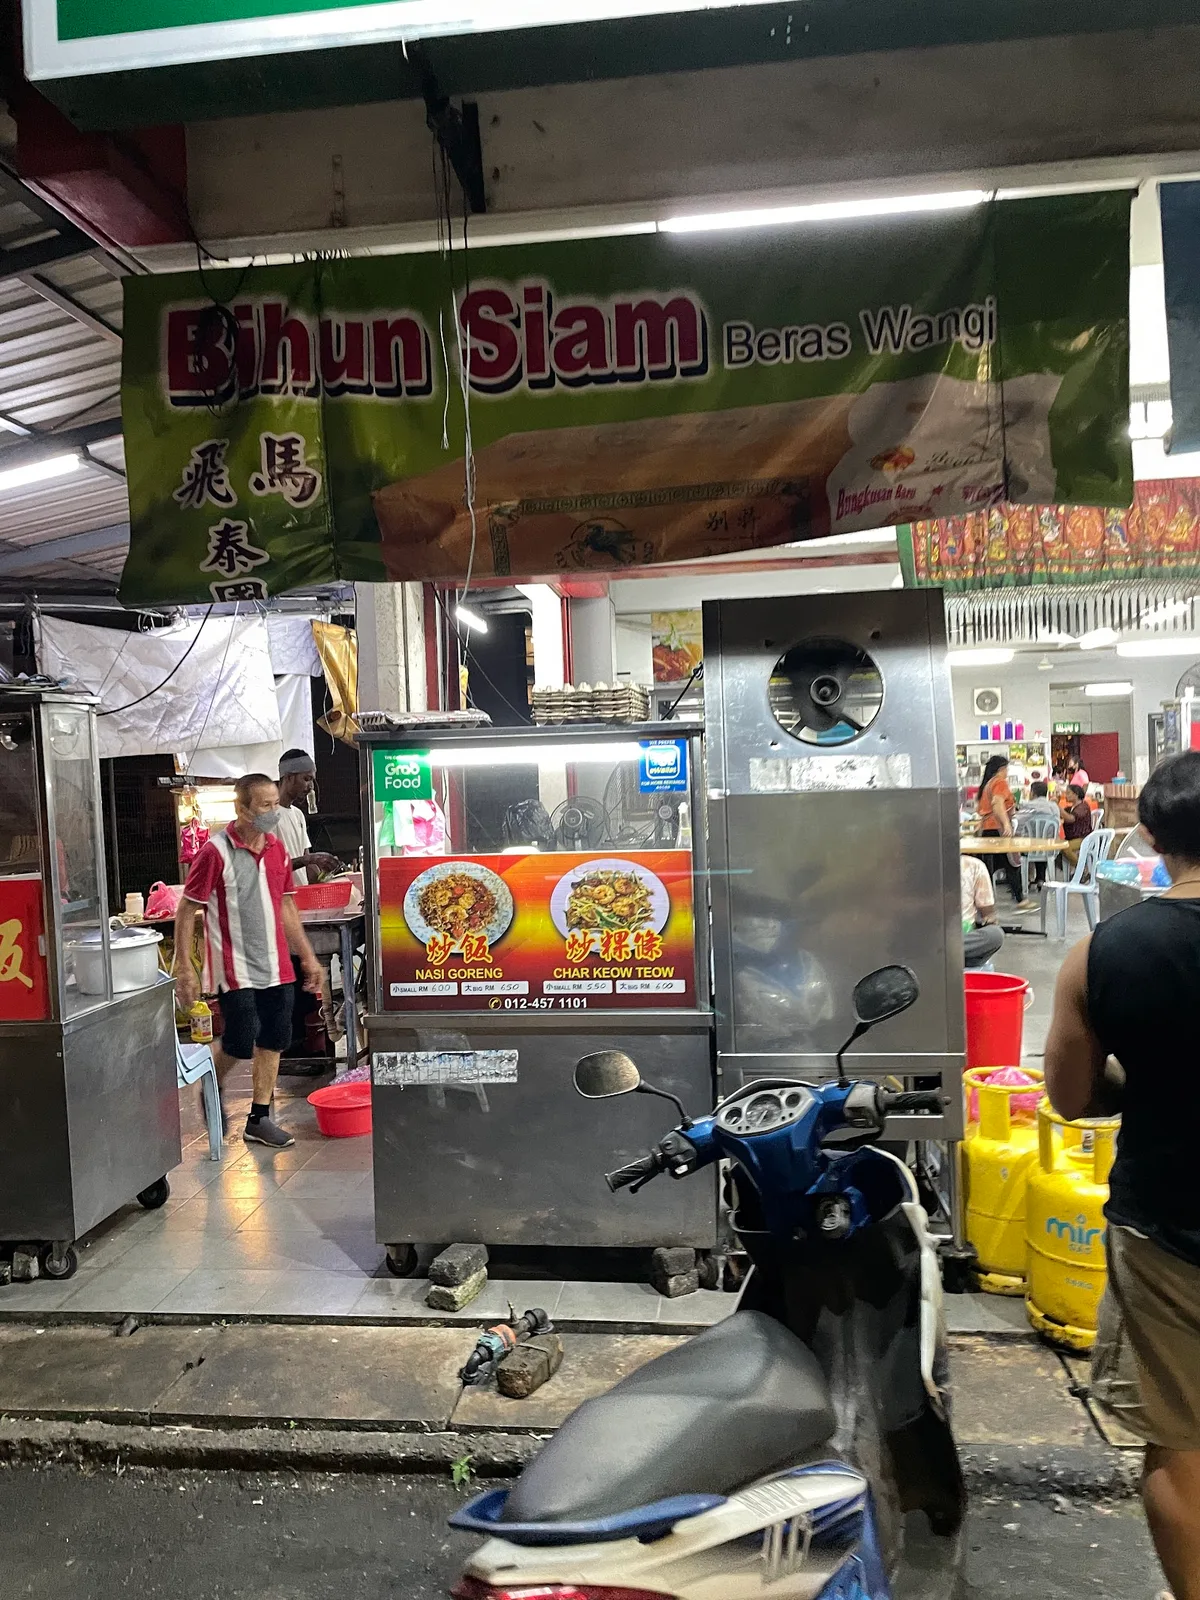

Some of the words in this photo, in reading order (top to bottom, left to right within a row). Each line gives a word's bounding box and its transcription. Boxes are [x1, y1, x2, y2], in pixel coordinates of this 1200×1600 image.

[165, 300, 433, 406] Bihun
[458, 285, 709, 394] Siam
[725, 322, 850, 367] Beras
[860, 297, 997, 353] Wangi
[385, 775, 421, 789] Food
[426, 931, 493, 965] 炒飯
[565, 929, 663, 962] 炒粿條
[415, 969, 444, 980] NASI
[447, 968, 503, 979] GORENG
[553, 967, 589, 979] CHAR
[593, 967, 632, 978] KEOW
[635, 966, 674, 978] TEOW
[505, 998, 554, 1009] 012-457
[558, 997, 587, 1008] 1101
